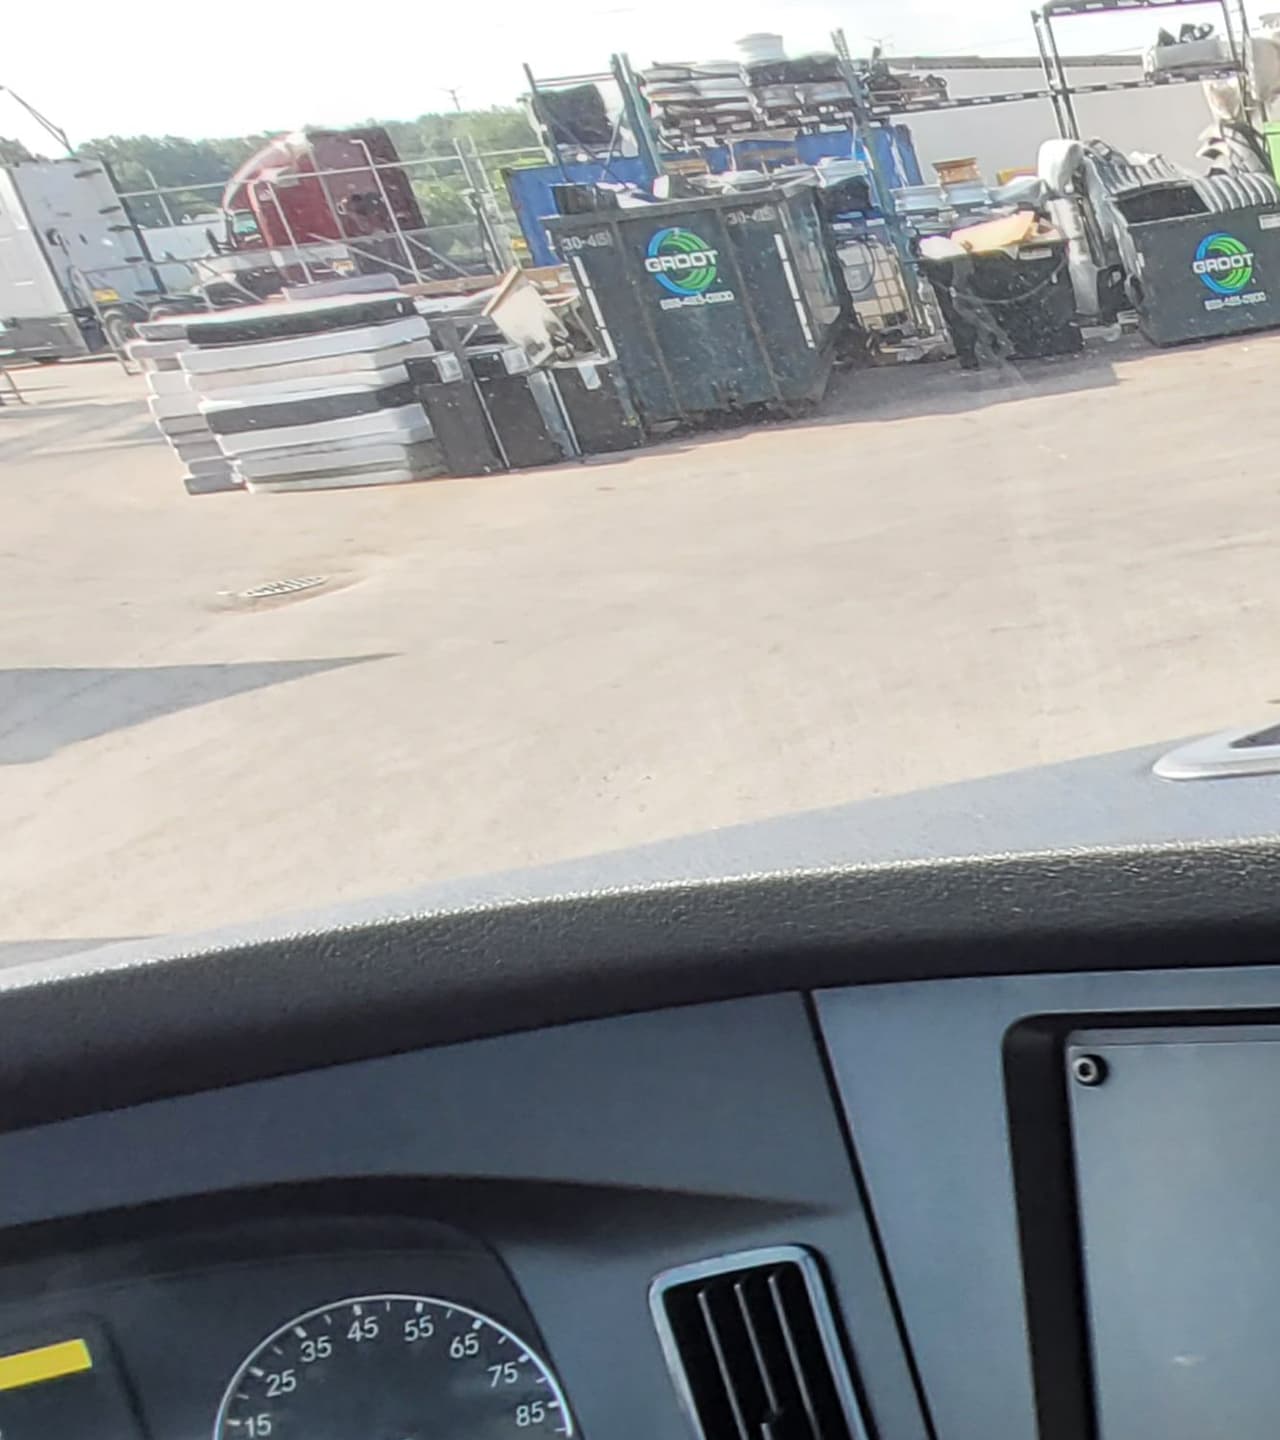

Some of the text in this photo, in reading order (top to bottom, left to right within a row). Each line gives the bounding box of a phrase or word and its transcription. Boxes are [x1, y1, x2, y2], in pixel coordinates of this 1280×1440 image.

[645, 250, 719, 274] GROOT
[1192, 252, 1254, 275] GROOT
[347, 1316, 379, 1342] 45
[403, 1315, 434, 1341] 55
[300, 1335, 332, 1363] 35
[450, 1333, 479, 1359] 65
[266, 1369, 297, 1397] 25
[487, 1361, 519, 1387] 75
[245, 1414, 272, 1438] 15
[515, 1401, 545, 1427] 85
